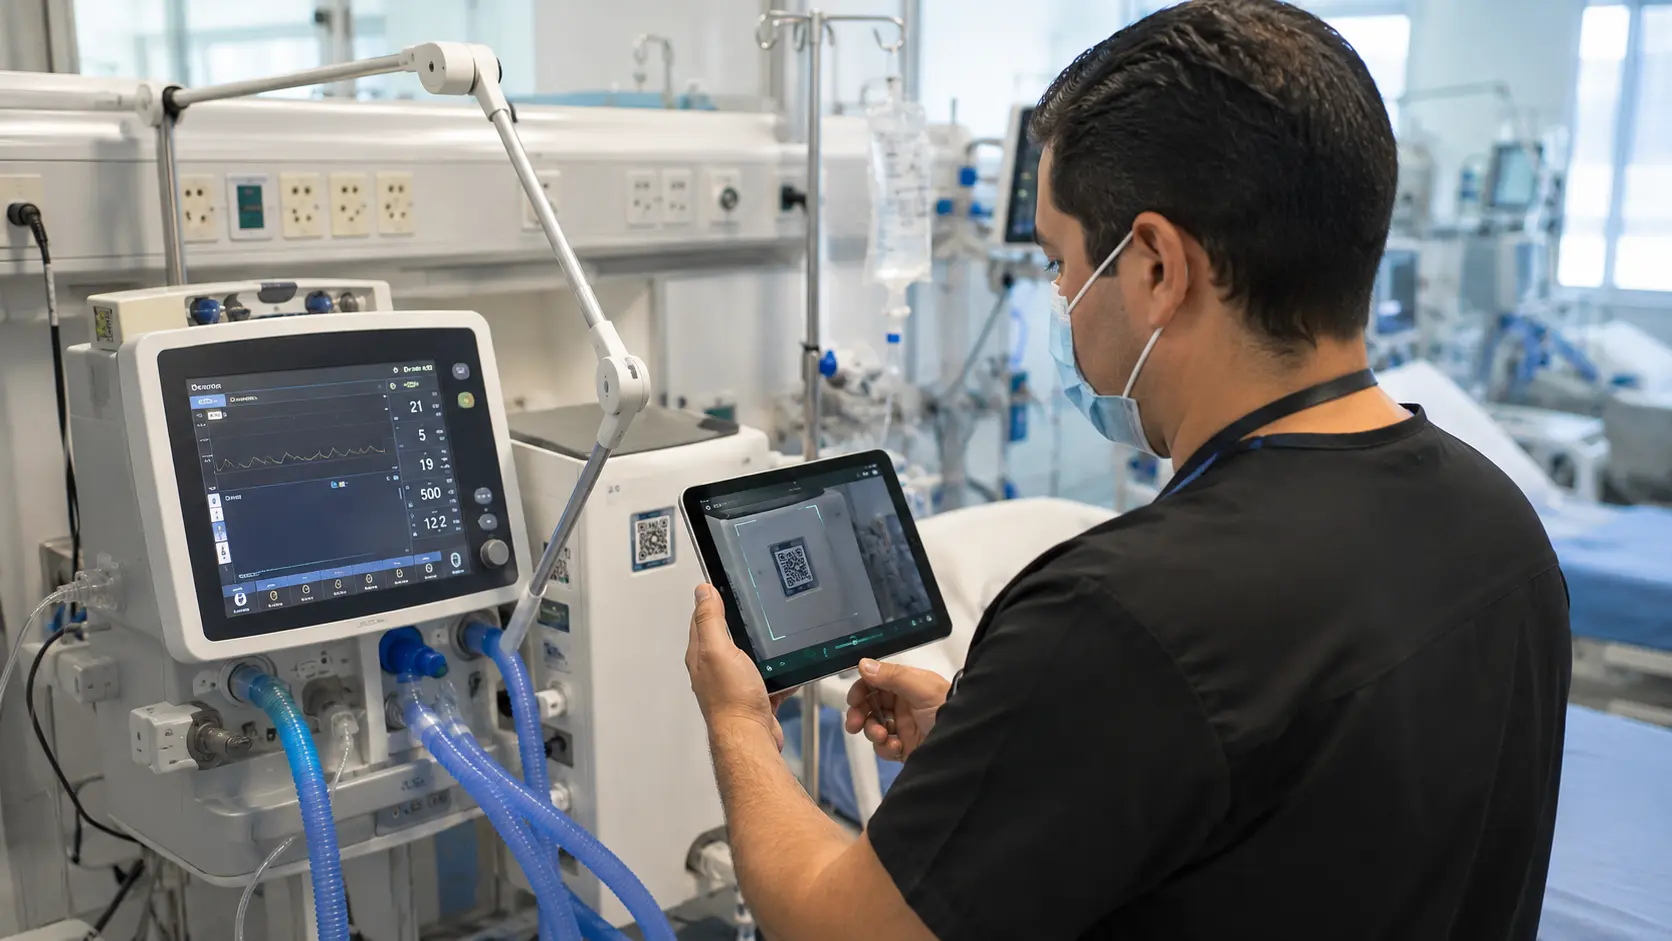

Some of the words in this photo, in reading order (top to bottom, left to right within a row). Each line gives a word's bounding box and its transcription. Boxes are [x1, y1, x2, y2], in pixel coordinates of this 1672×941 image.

[409, 400, 423, 413] 21
[418, 429, 426, 441] 5
[419, 458, 434, 471] 19
[420, 486, 441, 501] 500
